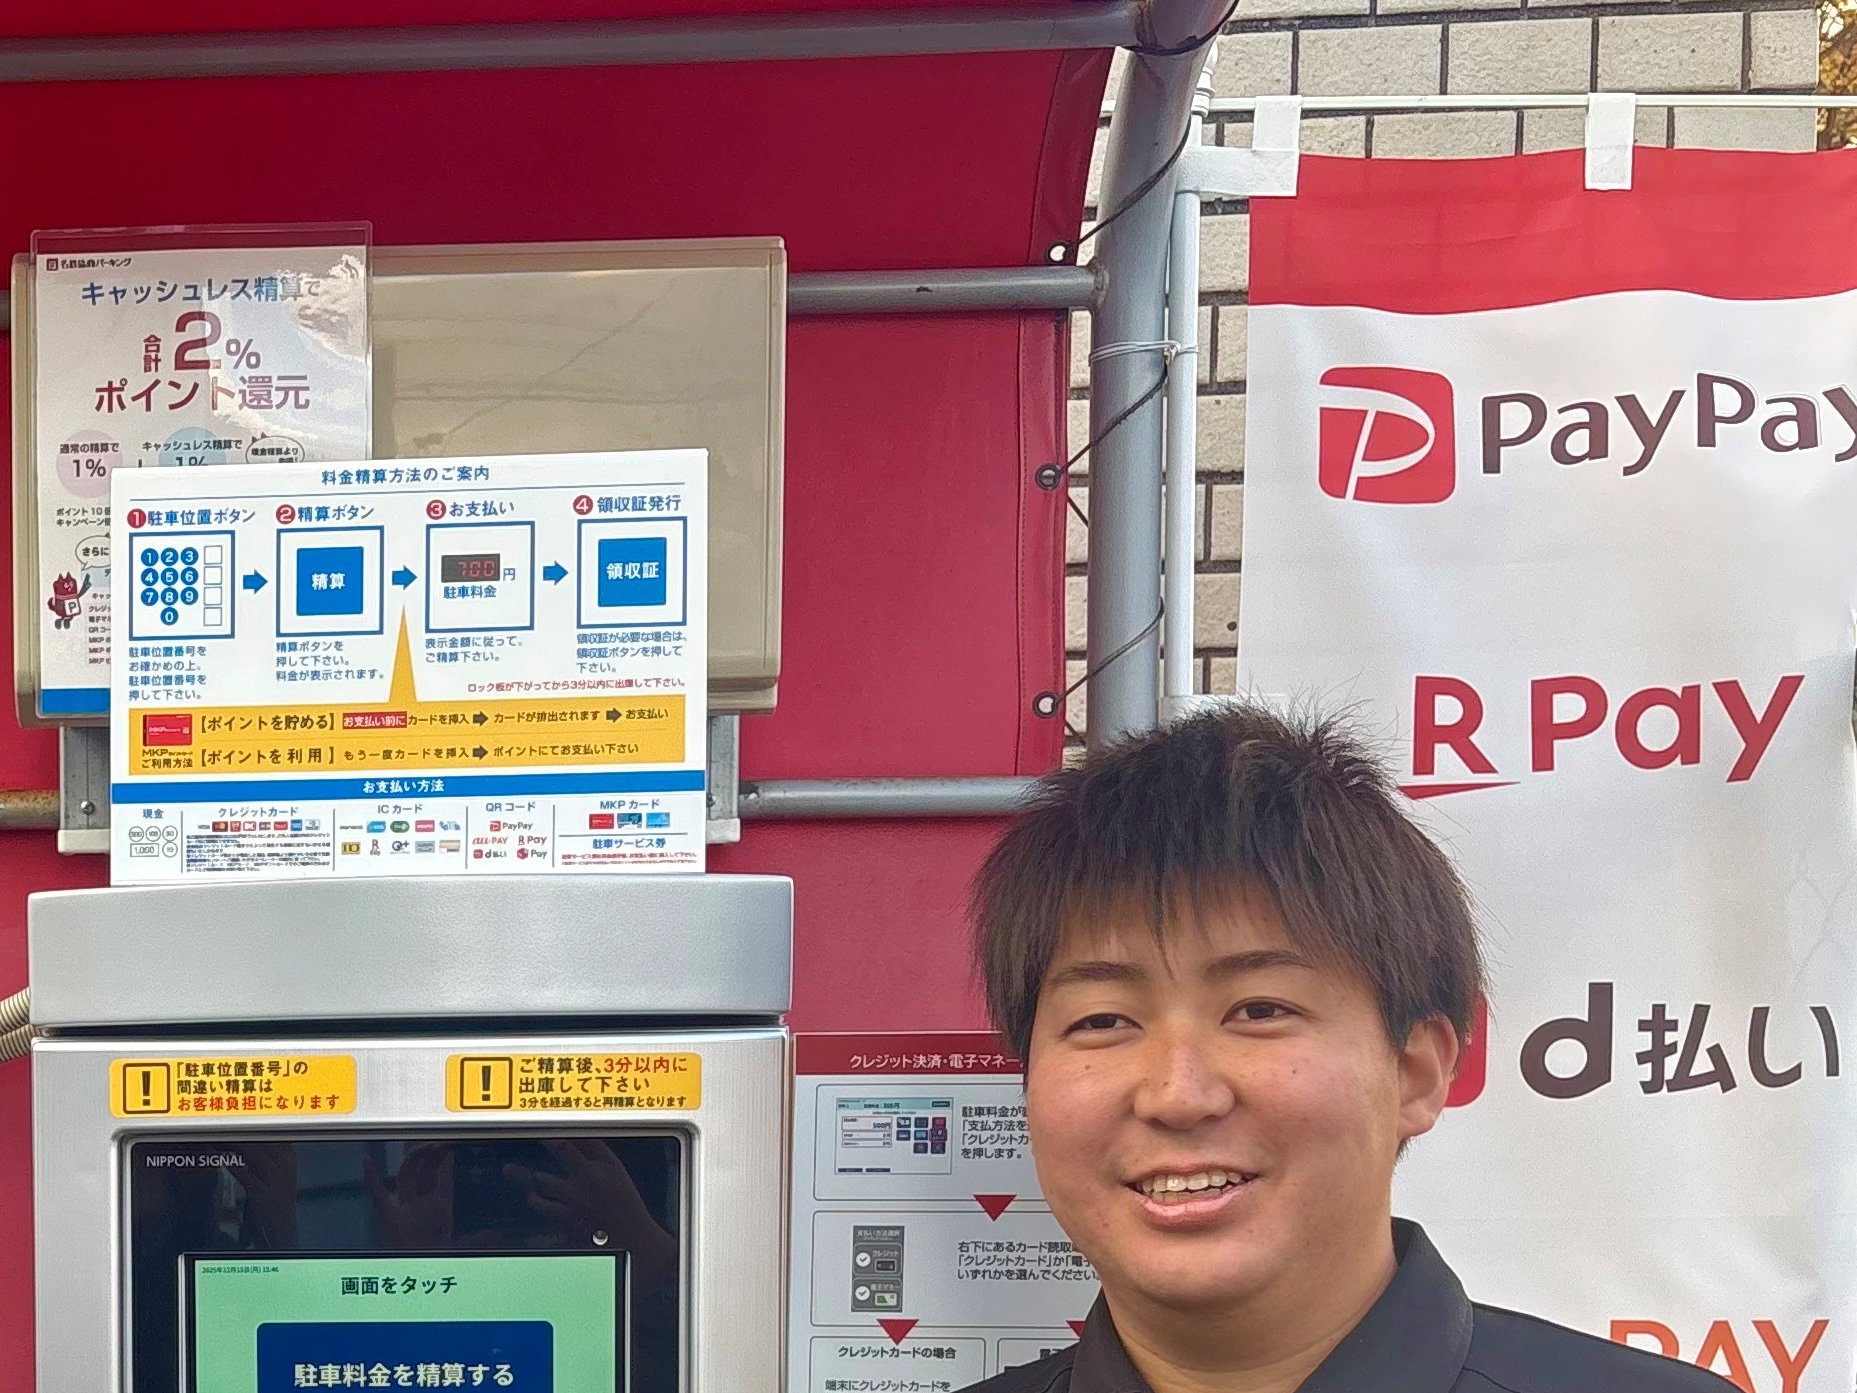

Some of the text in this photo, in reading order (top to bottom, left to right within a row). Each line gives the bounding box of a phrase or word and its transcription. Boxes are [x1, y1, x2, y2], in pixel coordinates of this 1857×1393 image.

[82, 277, 320, 306] キャッシュレス精算で
[94, 375, 310, 414] ポイント還元
[72, 459, 106, 478] 1%
[321, 466, 490, 485] 料金精算方法のご案内
[449, 500, 515, 517] お支払い
[597, 495, 682, 513] 領収証発行
[147, 508, 256, 527] 駐車位置ボタン
[297, 505, 375, 522] 精算ボタン
[503, 568, 516, 581] 円
[606, 562, 660, 580] 領収証
[312, 573, 346, 590] 精算
[443, 585, 497, 599] 駐車料金
[276, 640, 344, 653] 精算ボタンを
[576, 660, 617, 674] 下さい。
[201, 712, 335, 733] 【ポイントを貯める】
[625, 707, 669, 720] お支払い
[1531, 675, 1806, 783] Pay
[493, 743, 639, 758] ポイントにてお支払い下さい
[142, 757, 193, 769] ご利用方法
[362, 778, 445, 795] お支払い方法
[143, 808, 164, 819] 現金
[218, 806, 299, 818] クレジットカード
[502, 821, 533, 831] PayPay
[593, 838, 667, 849] 駐車サービス券
[175, 1060, 309, 1078] 「駐車位置番号」の
[519, 1056, 688, 1075] ご精算後、3分以内に
[850, 1052, 1024, 1069] クレジット決済・電子マネー
[176, 1078, 274, 1095] 間違い精算は
[519, 1075, 650, 1093] 出庫して下さい
[177, 1094, 341, 1112] お客様負担になります
[962, 1119, 1030, 1132] 「支払方法を
[962, 1132, 1031, 1145] 「クレジットカ
[146, 1154, 246, 1167] NIPPON SIGNAL
[961, 1148, 1022, 1159] を押します。
[341, 1275, 458, 1296] 画面をタッチ
[838, 1346, 957, 1359] クレジットカードの場合
[294, 1362, 514, 1388] 駐車料金を精算する
